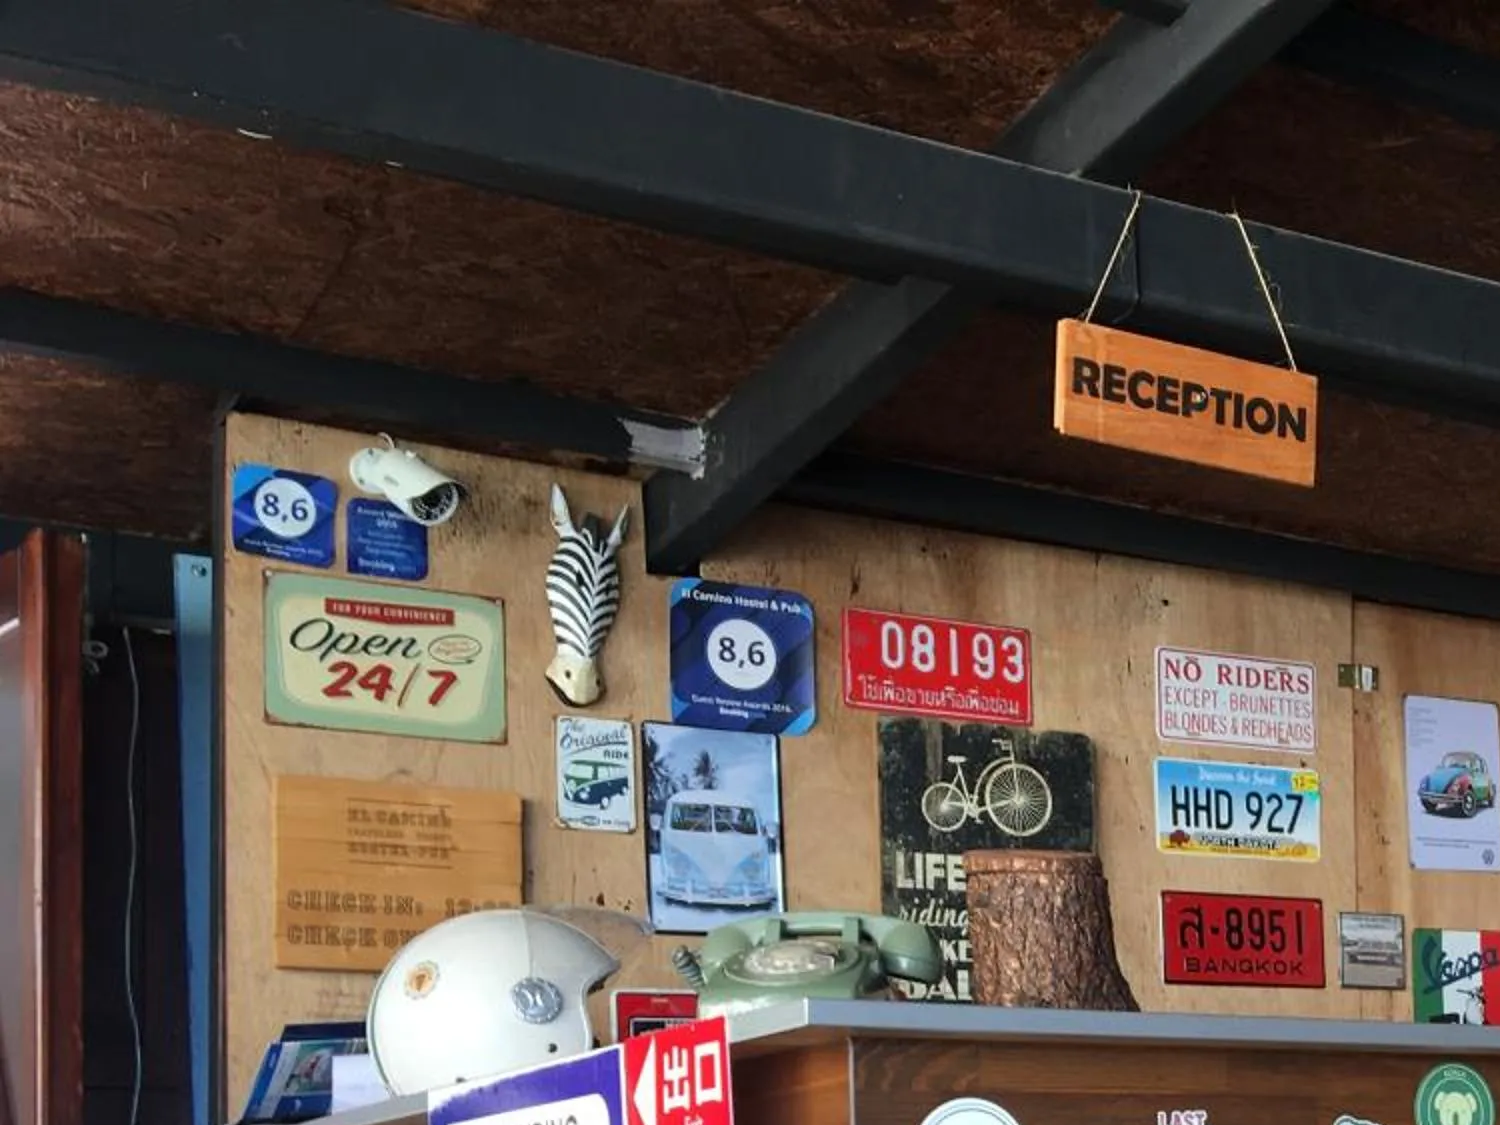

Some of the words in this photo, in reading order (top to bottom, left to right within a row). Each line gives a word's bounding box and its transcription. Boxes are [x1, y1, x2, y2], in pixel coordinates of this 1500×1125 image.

[1071, 356, 1307, 442] RECEPTION
[261, 492, 309, 522] 8,6
[289, 618, 423, 663] Open
[719, 637, 766, 668] 8,6
[881, 620, 1025, 684] 08193
[321, 660, 459, 708] 24/7
[1164, 656, 1202, 683] NO
[1217, 663, 1310, 694] RIDERS
[1164, 686, 1218, 709] EXCEPT
[1229, 692, 1311, 720] BRUNETTES
[1164, 709, 1227, 735] BLONDES
[1241, 718, 1313, 744] REDHEADS
[1170, 784, 1234, 830] HHD
[1245, 791, 1304, 834] 927
[896, 851, 967, 891] LIFE
[287, 889, 378, 914] CHECK
[287, 924, 378, 948] CHECK
[1184, 957, 1304, 976] BANGKOK
[1422, 936, 1500, 994] Vespa
[663, 1041, 722, 1114] 出口
